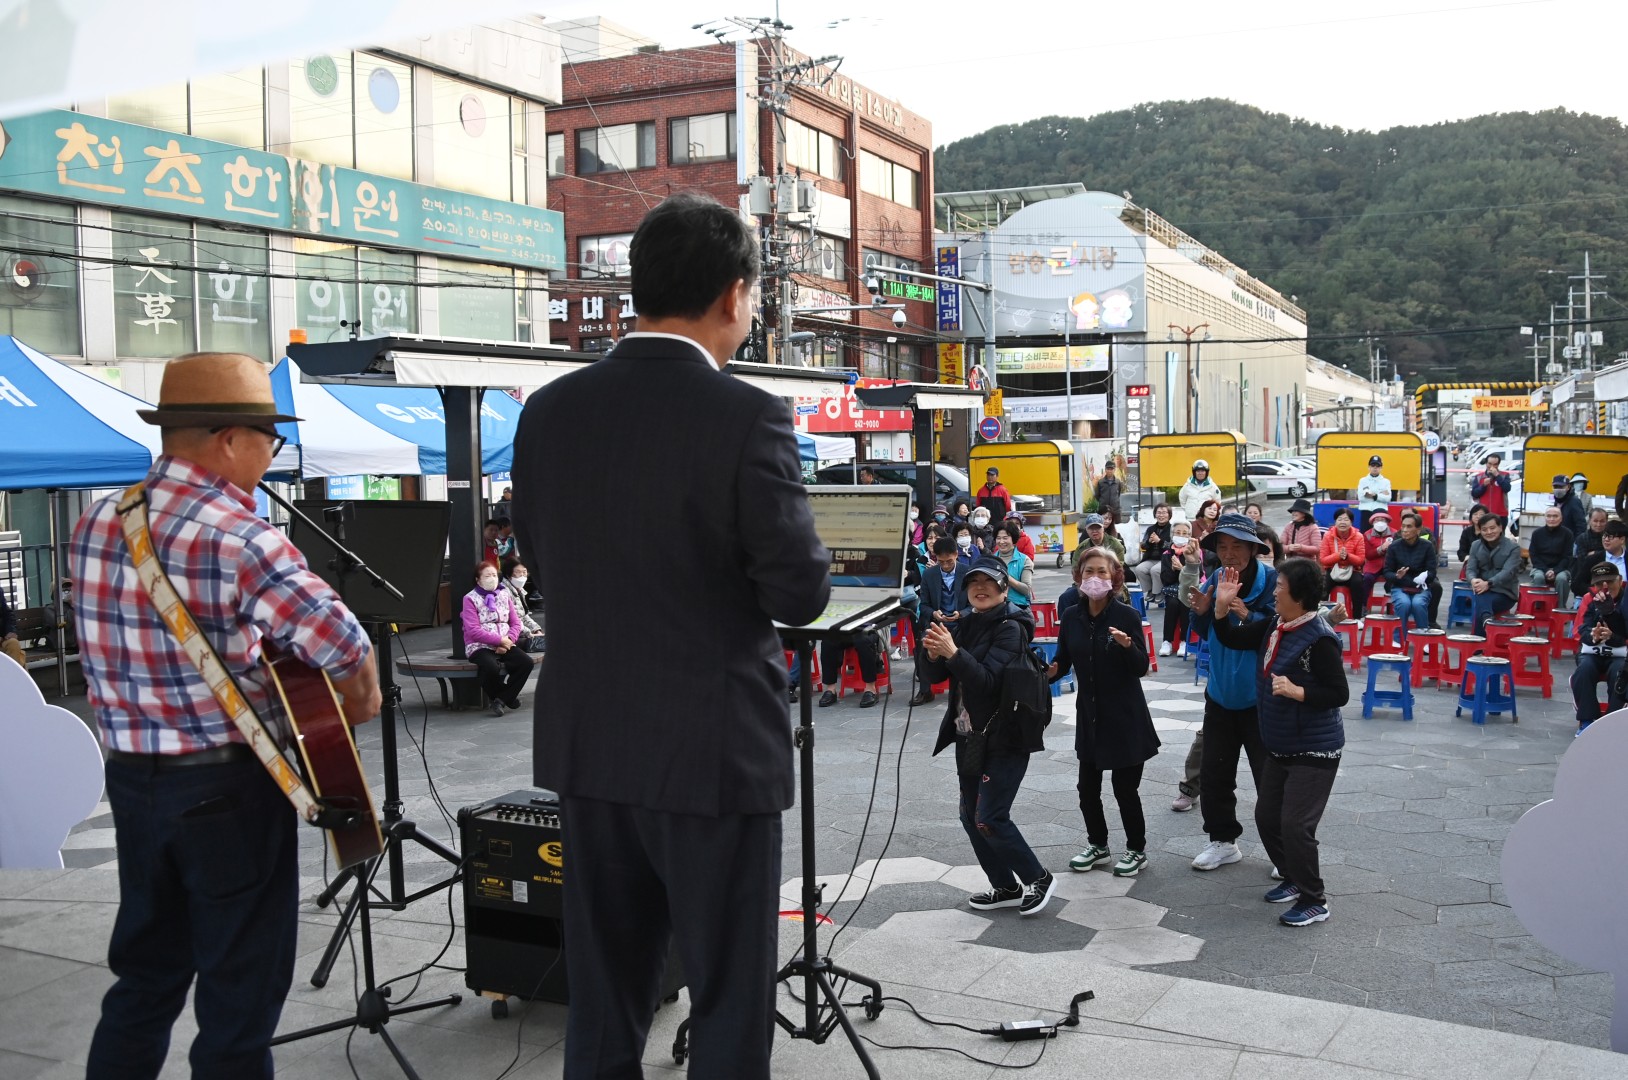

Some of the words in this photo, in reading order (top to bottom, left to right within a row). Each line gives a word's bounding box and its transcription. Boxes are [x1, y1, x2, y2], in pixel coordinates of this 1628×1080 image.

[511, 249, 557, 264] 545-7272
[1130, 387, 1149, 396] 5:12
[1426, 437, 1438, 448] 08
